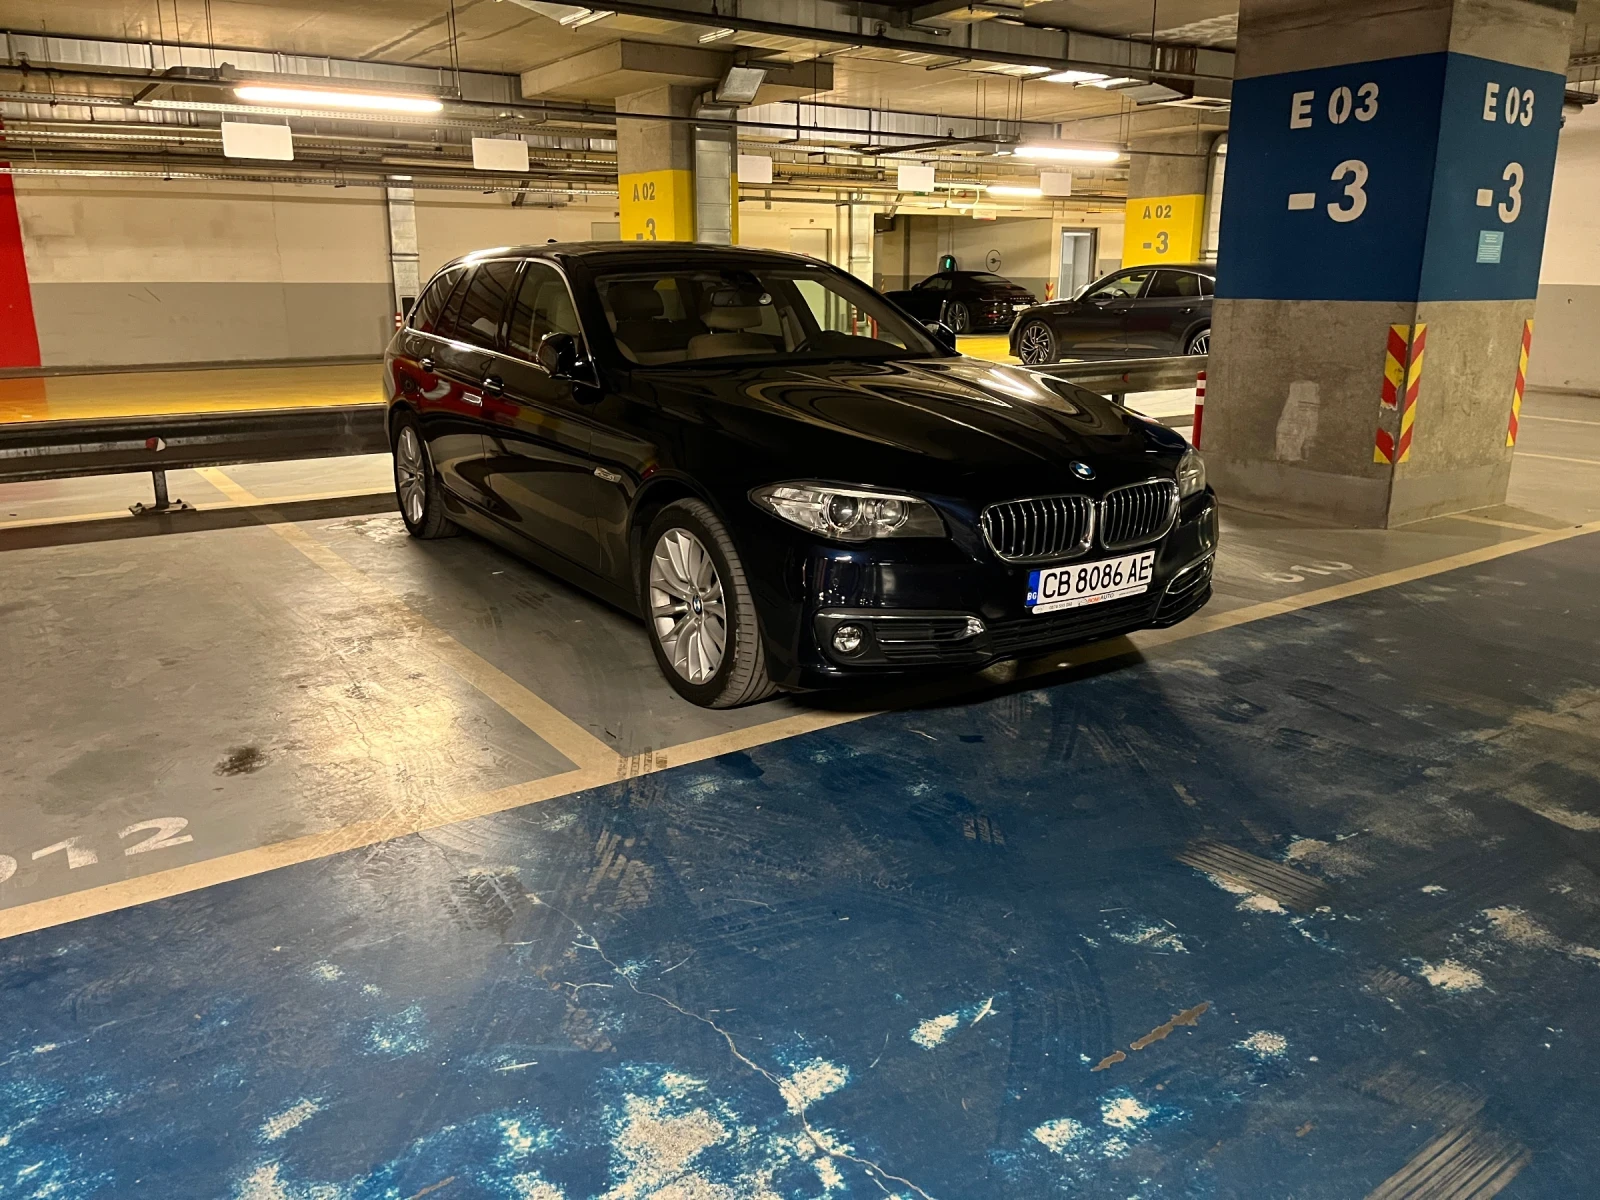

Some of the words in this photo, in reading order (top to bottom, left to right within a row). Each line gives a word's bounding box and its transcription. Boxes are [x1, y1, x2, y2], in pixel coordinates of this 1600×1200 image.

[1289, 90, 1315, 129] E
[1328, 82, 1379, 125] 03
[1482, 82, 1500, 121] E
[1505, 87, 1534, 127] 03
[632, 183, 640, 203] A
[642, 181, 656, 201] 02
[1142, 205, 1152, 220] A
[1155, 204, 1172, 219] 02
[1287, 159, 1369, 222] -3
[1475, 162, 1524, 223] -3
[1142, 231, 1169, 255] -3
[1026, 591, 1038, 601] BG
[1042, 570, 1071, 599] CB
[1075, 561, 1123, 594] 8086
[1126, 555, 1151, 584] AE
[0, 816, 194, 884] 12
